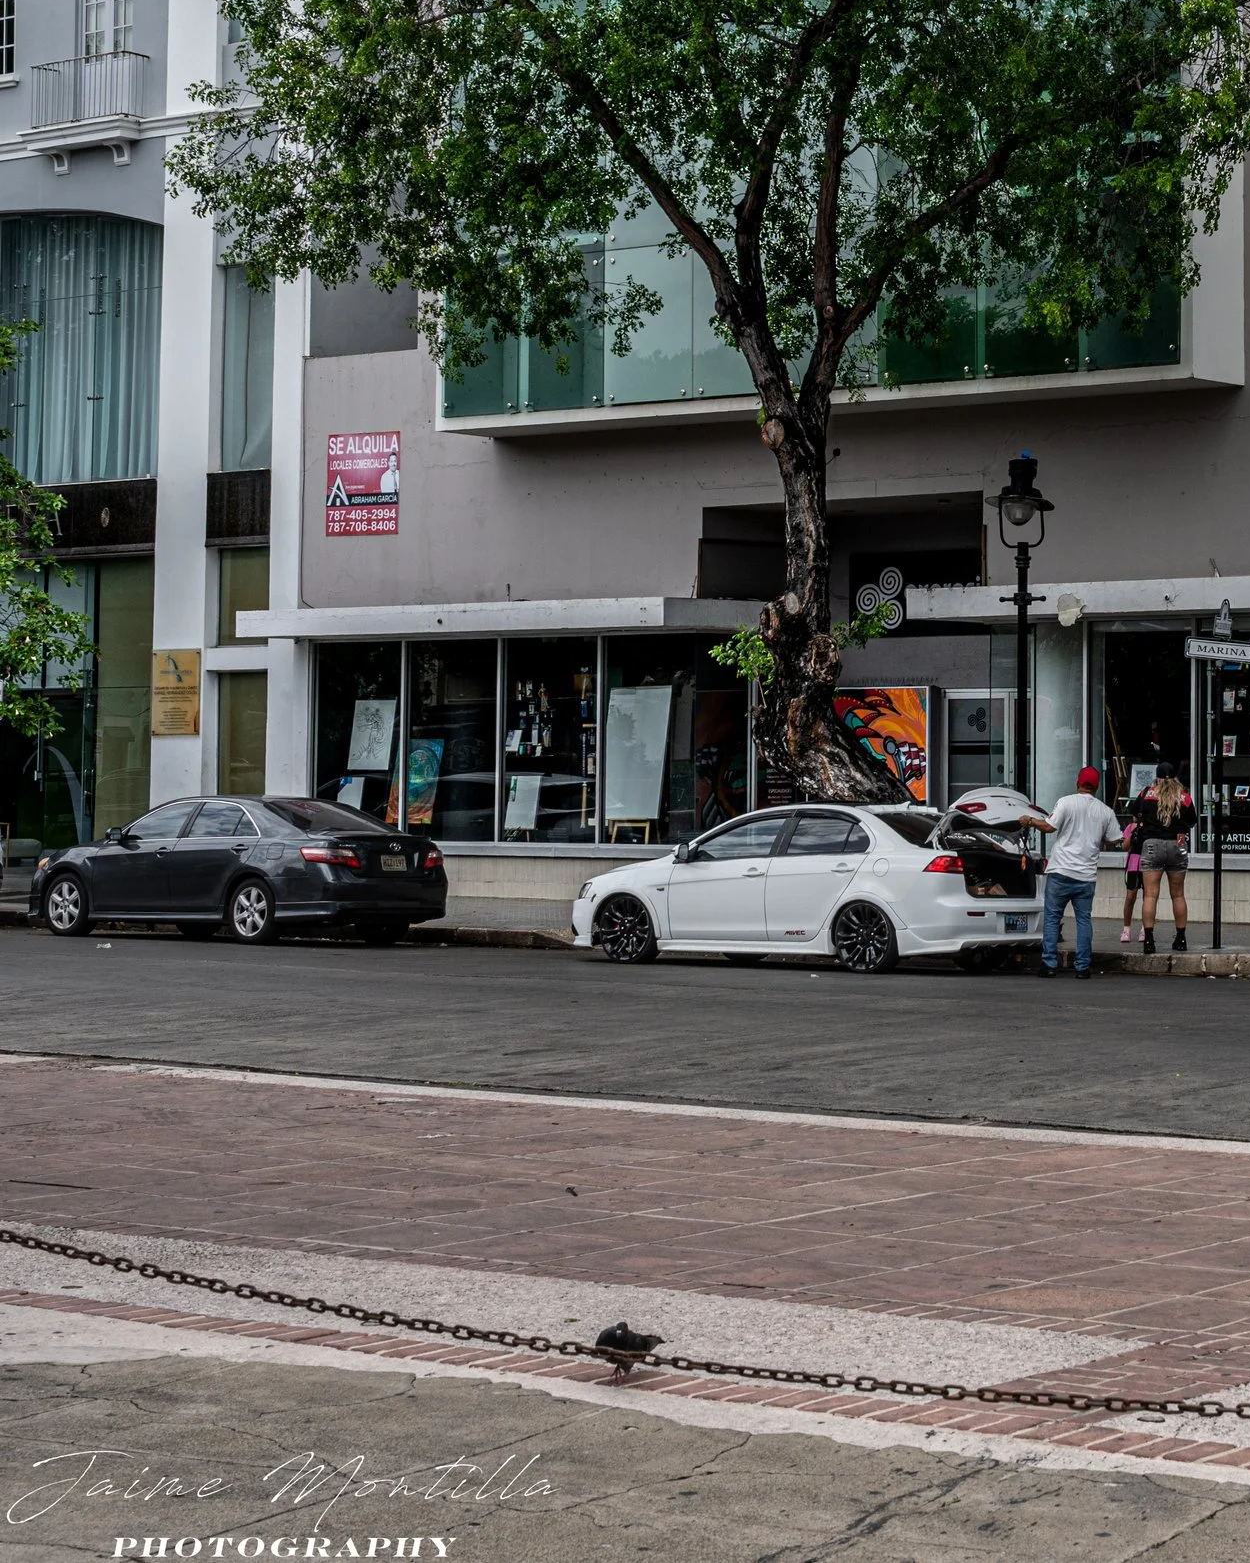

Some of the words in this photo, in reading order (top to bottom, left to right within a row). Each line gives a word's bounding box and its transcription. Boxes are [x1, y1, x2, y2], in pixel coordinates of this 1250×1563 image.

[329, 437, 345, 456] SE
[347, 434, 399, 455] ALQUILA
[330, 459, 352, 471] LOCALES
[353, 458, 388, 470] COMERCIALES
[351, 496, 377, 504] ABRAHAM
[377, 494, 398, 503] GARCÍA
[328, 509, 396, 521] 787-405-2994
[328, 520, 396, 533] 787-706-8406
[1197, 644, 1247, 657] MARINA
